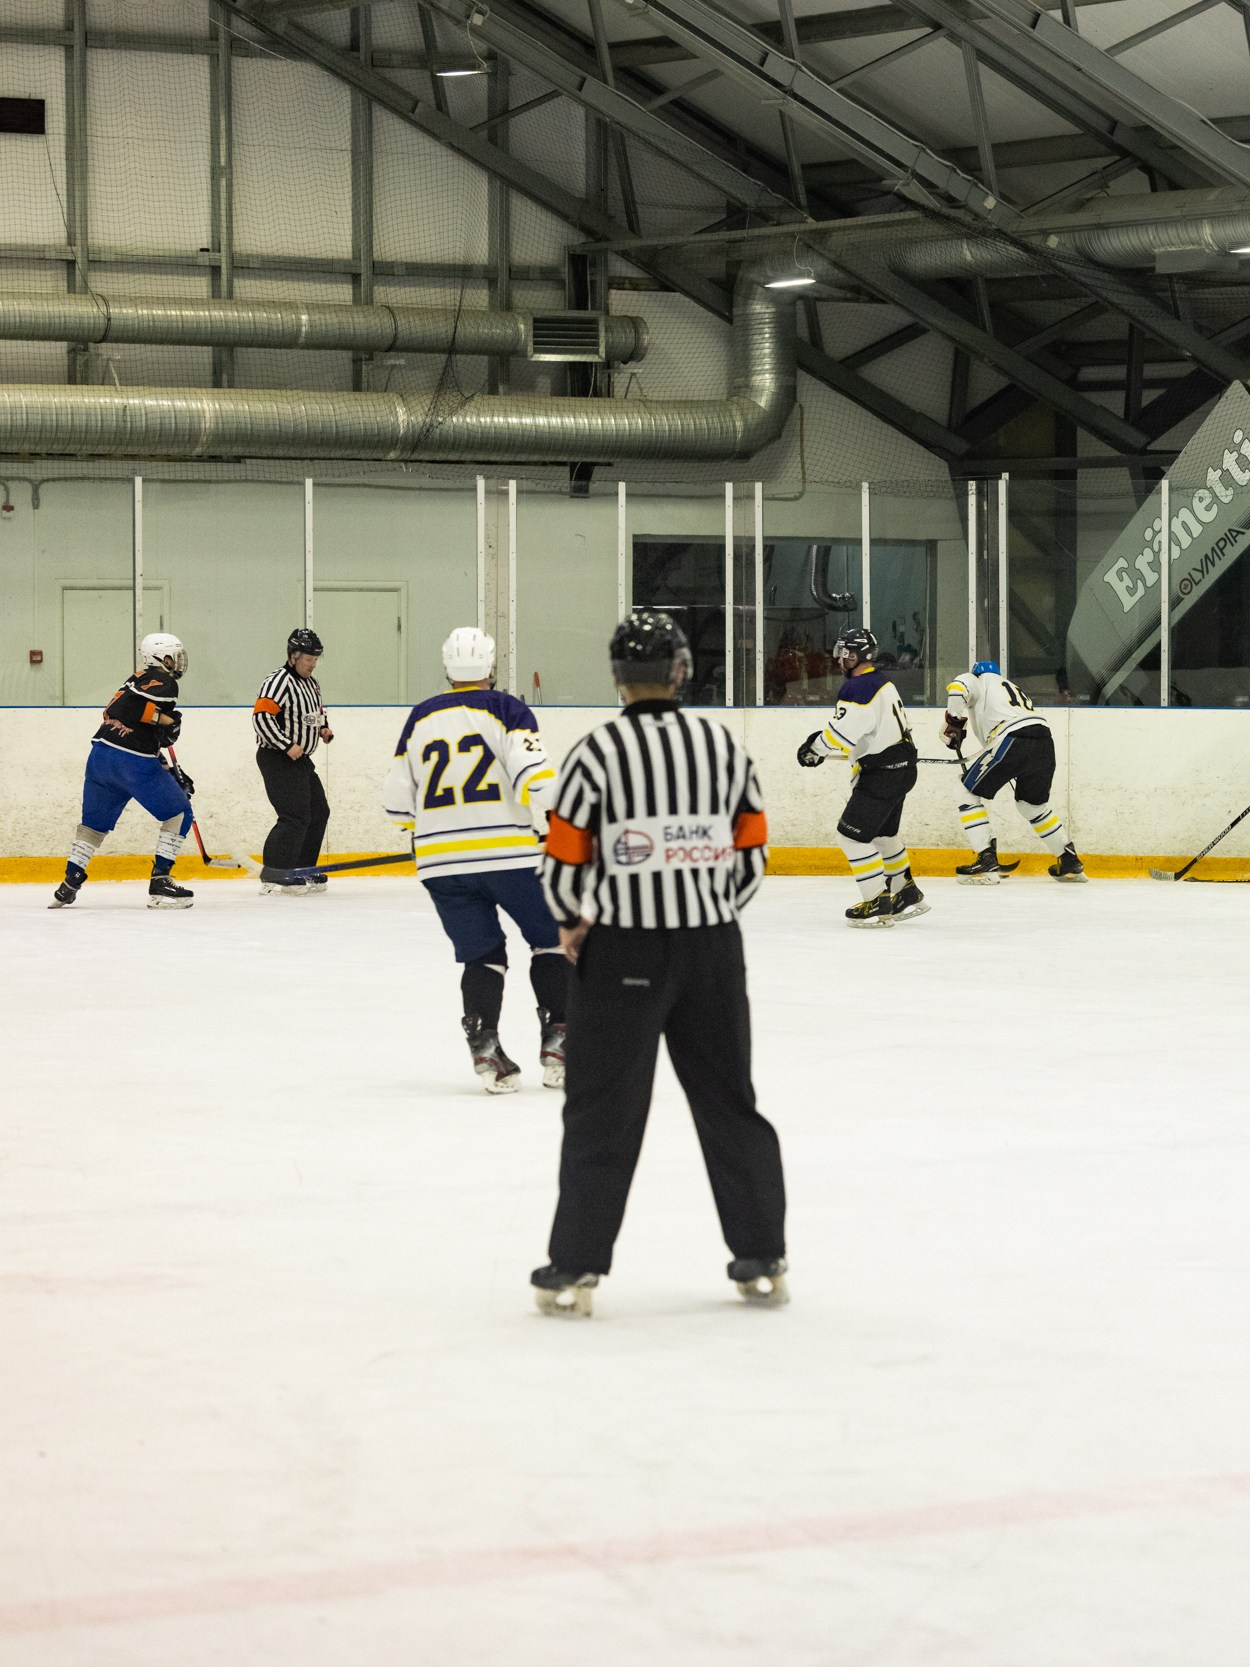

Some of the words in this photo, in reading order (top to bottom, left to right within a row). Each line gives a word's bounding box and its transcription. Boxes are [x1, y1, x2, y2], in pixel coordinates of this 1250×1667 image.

[1178, 527, 1246, 596] OLYMPIA
[422, 732, 502, 811] 22
[663, 824, 714, 842] БАНК
